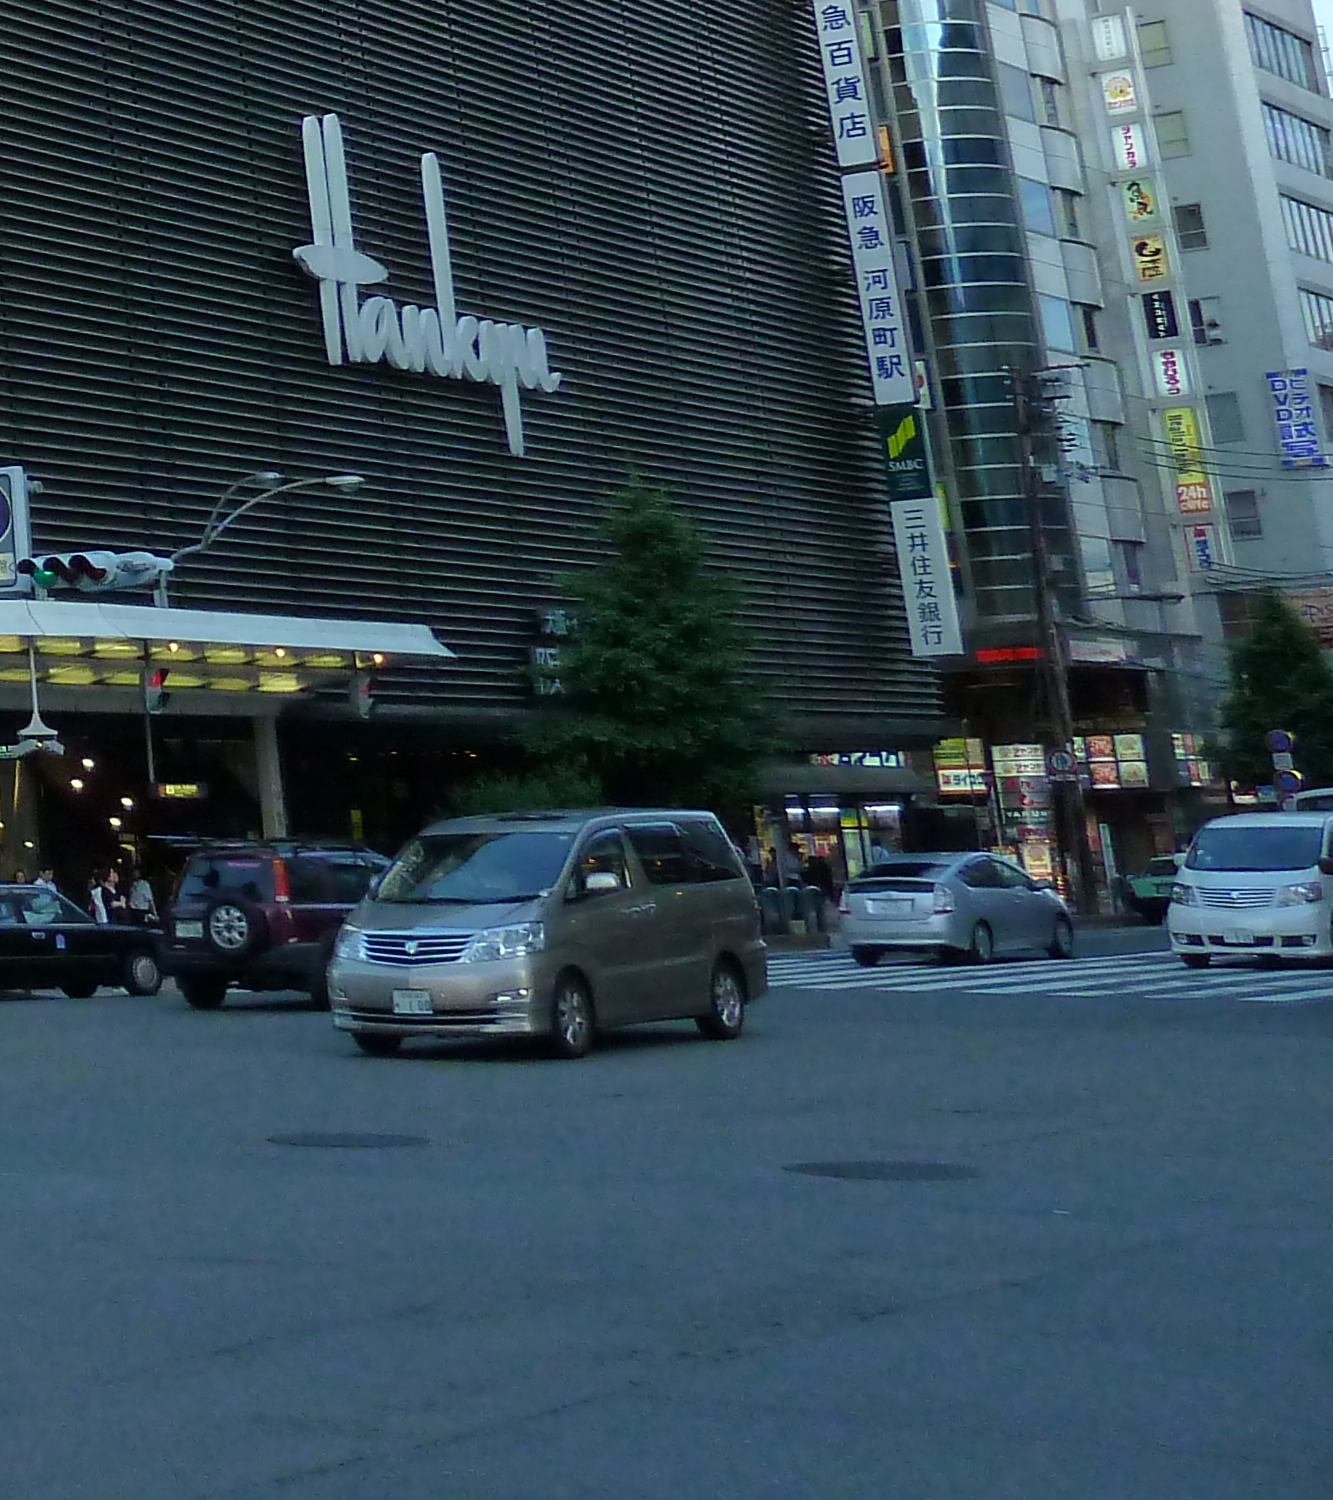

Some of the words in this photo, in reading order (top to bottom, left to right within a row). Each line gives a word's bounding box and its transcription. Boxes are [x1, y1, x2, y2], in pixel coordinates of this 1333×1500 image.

[292, 112, 563, 458] Hankyu
[888, 459, 924, 472] SMBC
[903, 508, 943, 646] 三井住友銀行
